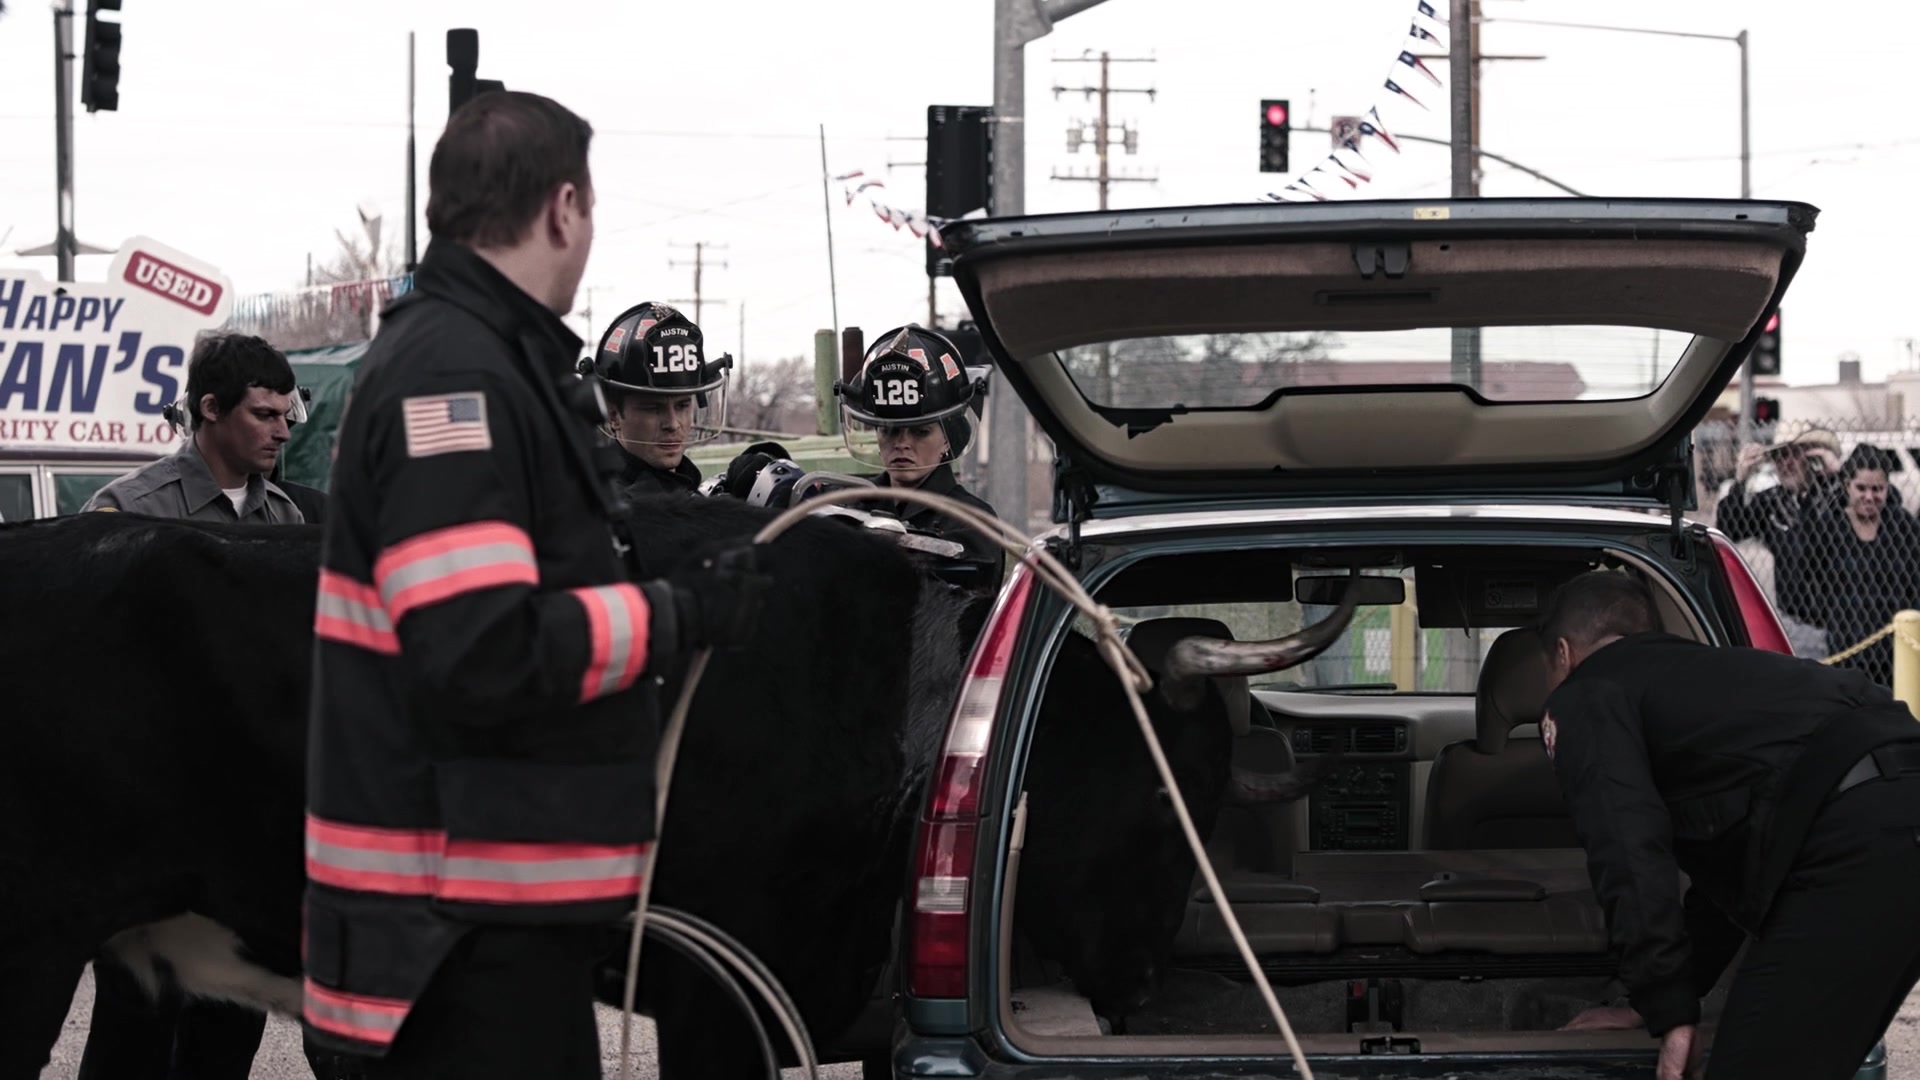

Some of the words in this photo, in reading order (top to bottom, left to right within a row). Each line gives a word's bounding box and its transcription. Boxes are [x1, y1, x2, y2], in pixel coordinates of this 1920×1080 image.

[135, 258, 213, 307] USED
[661, 328, 689, 338] AUSTIN
[653, 344, 698, 373] 126
[881, 363, 910, 372] AUSTIN
[0, 332, 184, 415] AN'S
[873, 379, 919, 405] 126
[69, 421, 126, 442] CAR
[137, 422, 178, 444] LO
